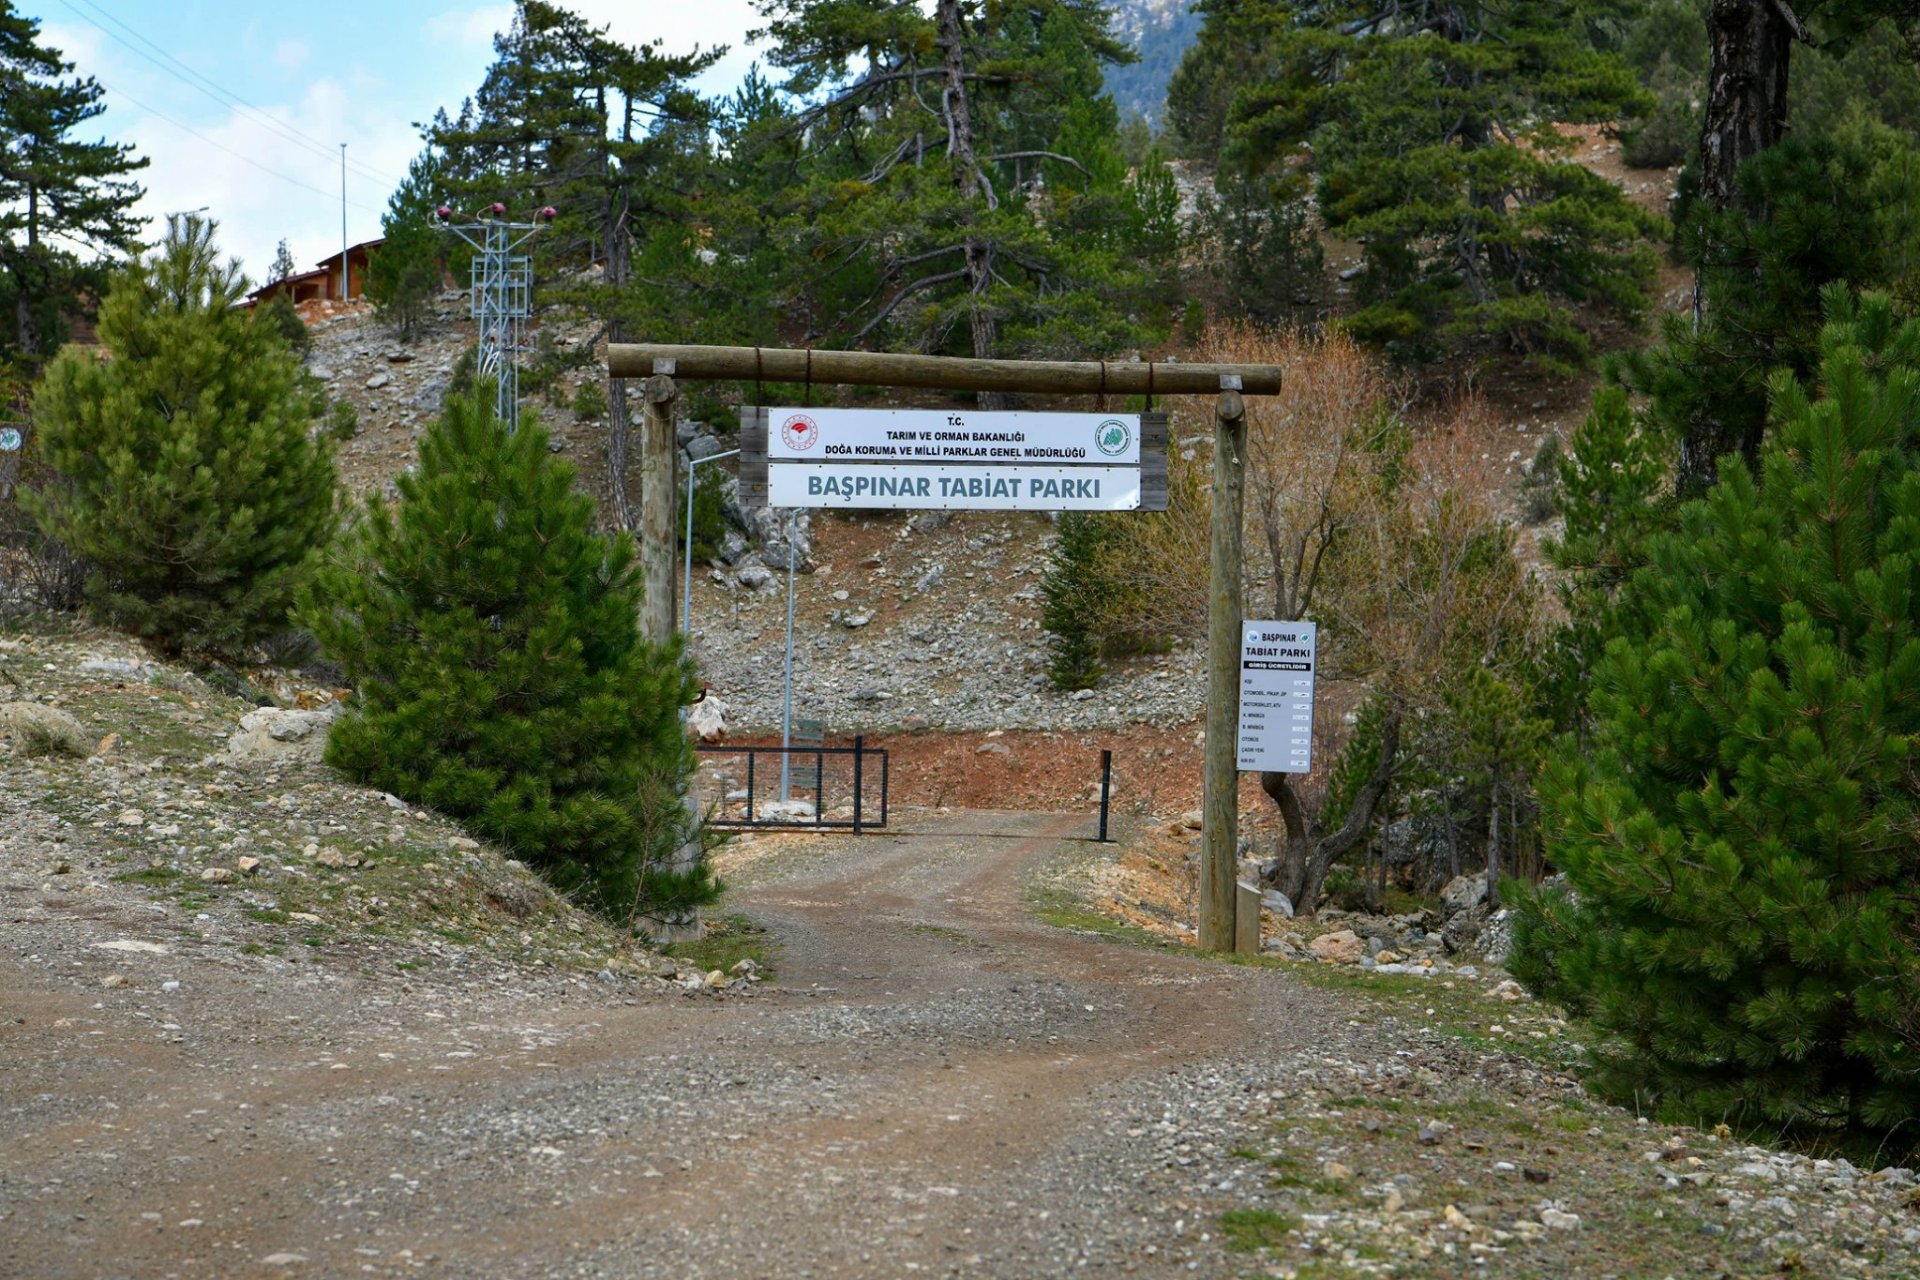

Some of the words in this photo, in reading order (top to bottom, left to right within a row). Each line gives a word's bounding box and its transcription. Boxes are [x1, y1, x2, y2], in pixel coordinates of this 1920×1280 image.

[947, 416, 965, 426] T.C.
[886, 431, 917, 441] TARIM
[919, 431, 932, 440] VE
[934, 432, 969, 441] ORMAN
[972, 431, 1025, 442] BAKANLIĞI
[825, 443, 852, 455] DOĞA
[855, 446, 897, 455] KORUMA
[899, 446, 912, 455] VE
[915, 444, 940, 456] MİLLİ
[943, 447, 987, 457] PARKLAR
[990, 448, 1021, 457] GENEL
[1024, 447, 1086, 458] MÜDÜRLÜĞÜ
[808, 475, 930, 501] BAŞPINAR
[938, 472, 1021, 498] TABİAT
[1030, 478, 1100, 498] PARKI
[1262, 633, 1296, 643] BAŞPINAR
[1246, 645, 1278, 656] TABİAT
[1280, 647, 1310, 658] PARKI
